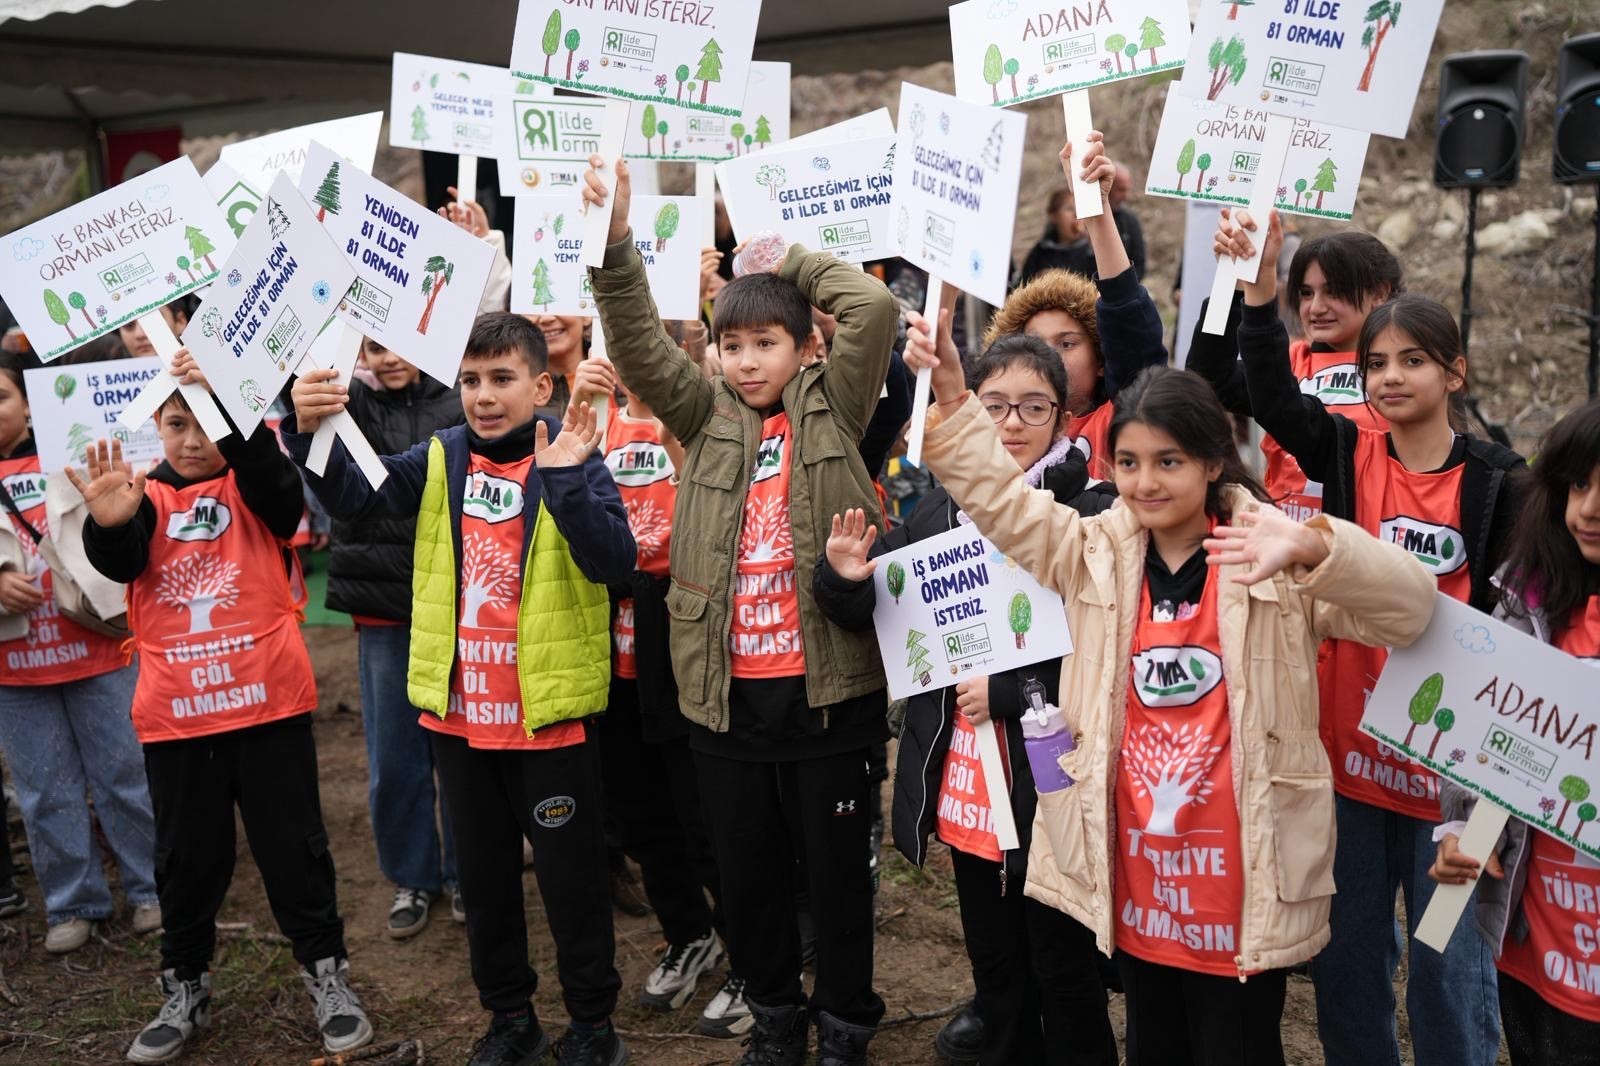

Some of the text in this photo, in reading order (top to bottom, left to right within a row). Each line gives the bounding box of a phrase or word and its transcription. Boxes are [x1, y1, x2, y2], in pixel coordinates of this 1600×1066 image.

[1022, 1, 1113, 42] ADANA
[1267, 21, 1345, 49] 81 ORMAN
[624, 33, 641, 45] ilde
[1063, 46, 1093, 57] orman
[1064, 41, 1079, 49] ilde
[622, 48, 652, 58] orman
[1288, 64, 1306, 76] ilde
[1285, 79, 1318, 91] orman
[559, 111, 592, 131] ilde
[1197, 119, 1266, 142] ORMANI
[562, 139, 599, 153] orm
[779, 172, 892, 203] GELECEĞİMİZ İÇİN
[73, 199, 146, 244] BANKASI
[365, 194, 419, 240] YENİDEN
[782, 207, 794, 221] 81
[798, 202, 828, 218] İLDE
[834, 198, 846, 212] 81
[361, 220, 407, 259] 81 İLDE
[839, 225, 854, 235] ilde
[840, 233, 868, 244] orman
[39, 236, 116, 281] ORMANI
[118, 261, 135, 274] ilde
[346, 238, 409, 288] 81 ORMAN
[122, 265, 151, 282] orman
[223, 268, 271, 343] GELECEĞİMİZ
[265, 240, 288, 272] İÇİN
[362, 285, 378, 301] ilde
[232, 256, 298, 358] 81 İLDE 81 ORMAN
[359, 297, 385, 319] orman
[275, 320, 286, 337] ilde
[279, 319, 299, 346] orman
[105, 369, 160, 385] BANKAS
[1315, 372, 1357, 390] TEMA
[618, 451, 655, 469] TEMA
[1392, 525, 1437, 555] TEMA
[911, 538, 985, 581] İŞ BANKASI
[735, 566, 795, 596] ÜRKİY
[920, 562, 990, 604] ORMANI
[739, 598, 784, 631] ÇÖL
[933, 596, 988, 627] İSTERİZ.
[458, 635, 517, 665] RKİYE
[730, 630, 801, 656] LMASI
[960, 632, 975, 643] ilde
[962, 640, 989, 654] orman
[7, 640, 88, 670] OLMASIN
[190, 659, 235, 692] ÇÖL
[463, 665, 490, 695] ÖL
[171, 682, 268, 719] OLMASIN
[1474, 675, 1598, 761] ADANA
[1512, 740, 1535, 758] ilde
[1507, 751, 1547, 777] orman
[1127, 828, 1227, 878] TRKİYE
[1541, 871, 1600, 914] TÜR
[1121, 898, 1235, 952] OLMASIN
